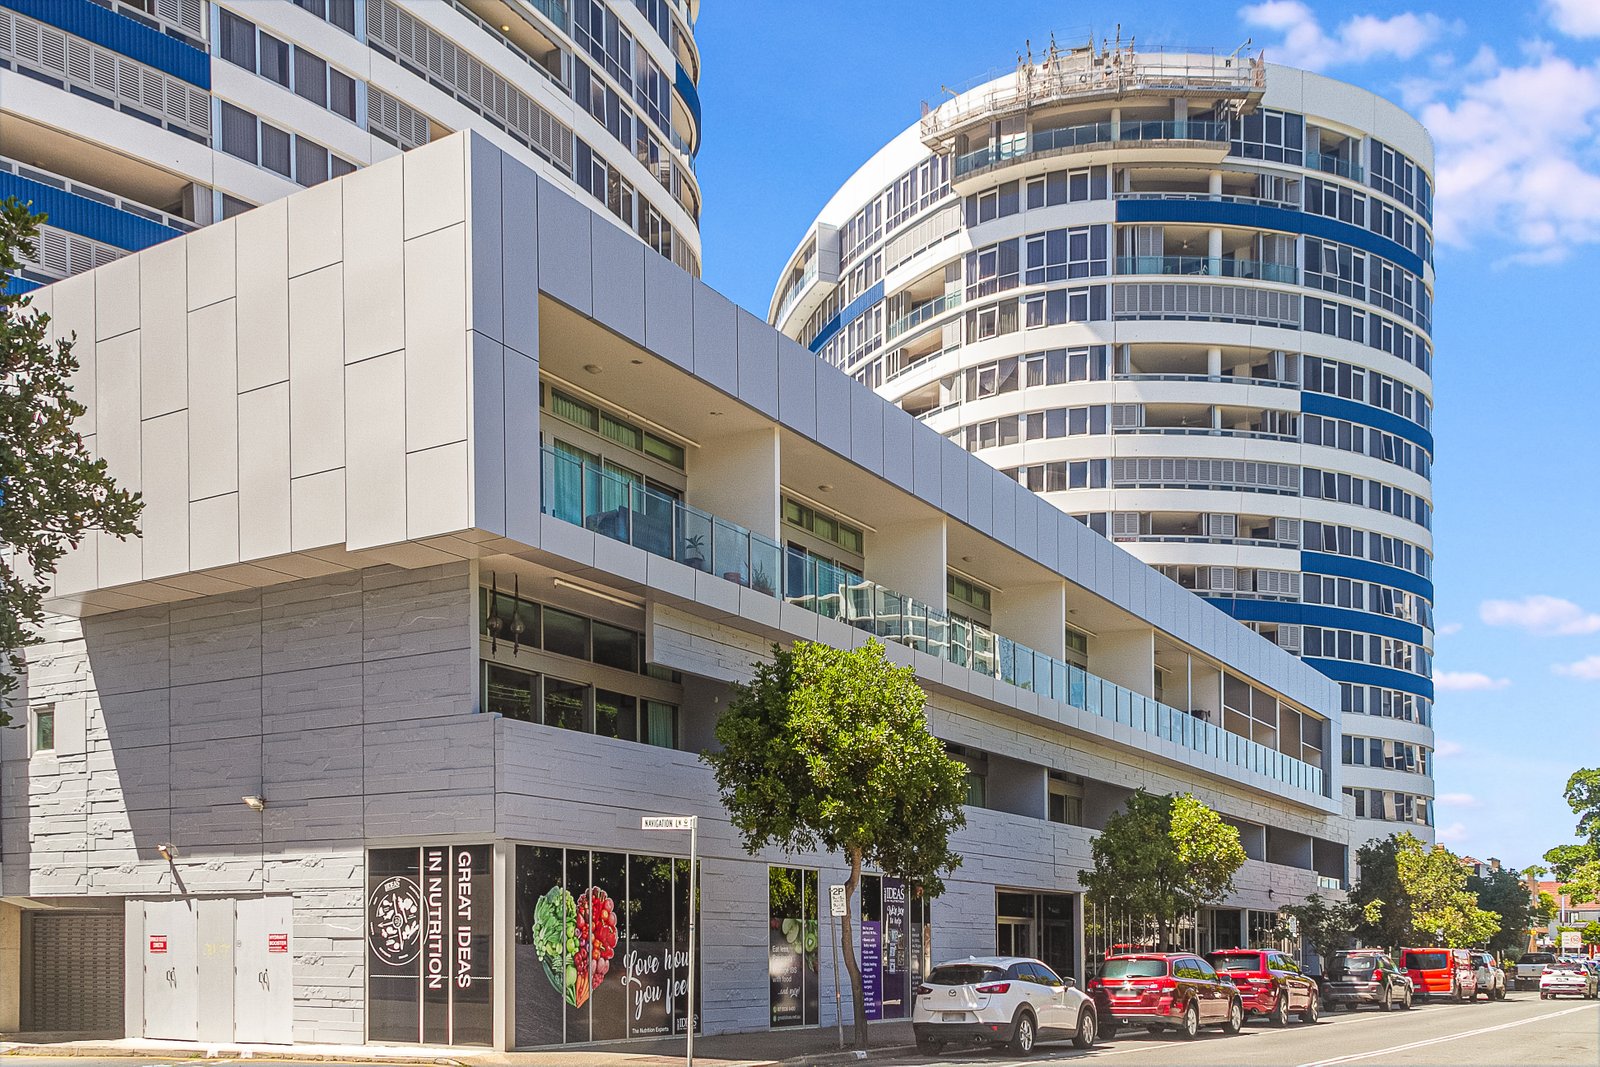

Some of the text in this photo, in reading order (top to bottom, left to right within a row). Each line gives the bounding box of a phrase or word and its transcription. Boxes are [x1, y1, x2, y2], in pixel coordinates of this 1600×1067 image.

[644, 819, 673, 828] NAVIGATION
[832, 887, 844, 896] 2P
[886, 886, 905, 901] IDEAS
[428, 851, 442, 989] IN NUTRITION
[457, 851, 472, 988] GREAT IDEAS
[621, 949, 660, 988] Love
[634, 978, 690, 1021] you fee
